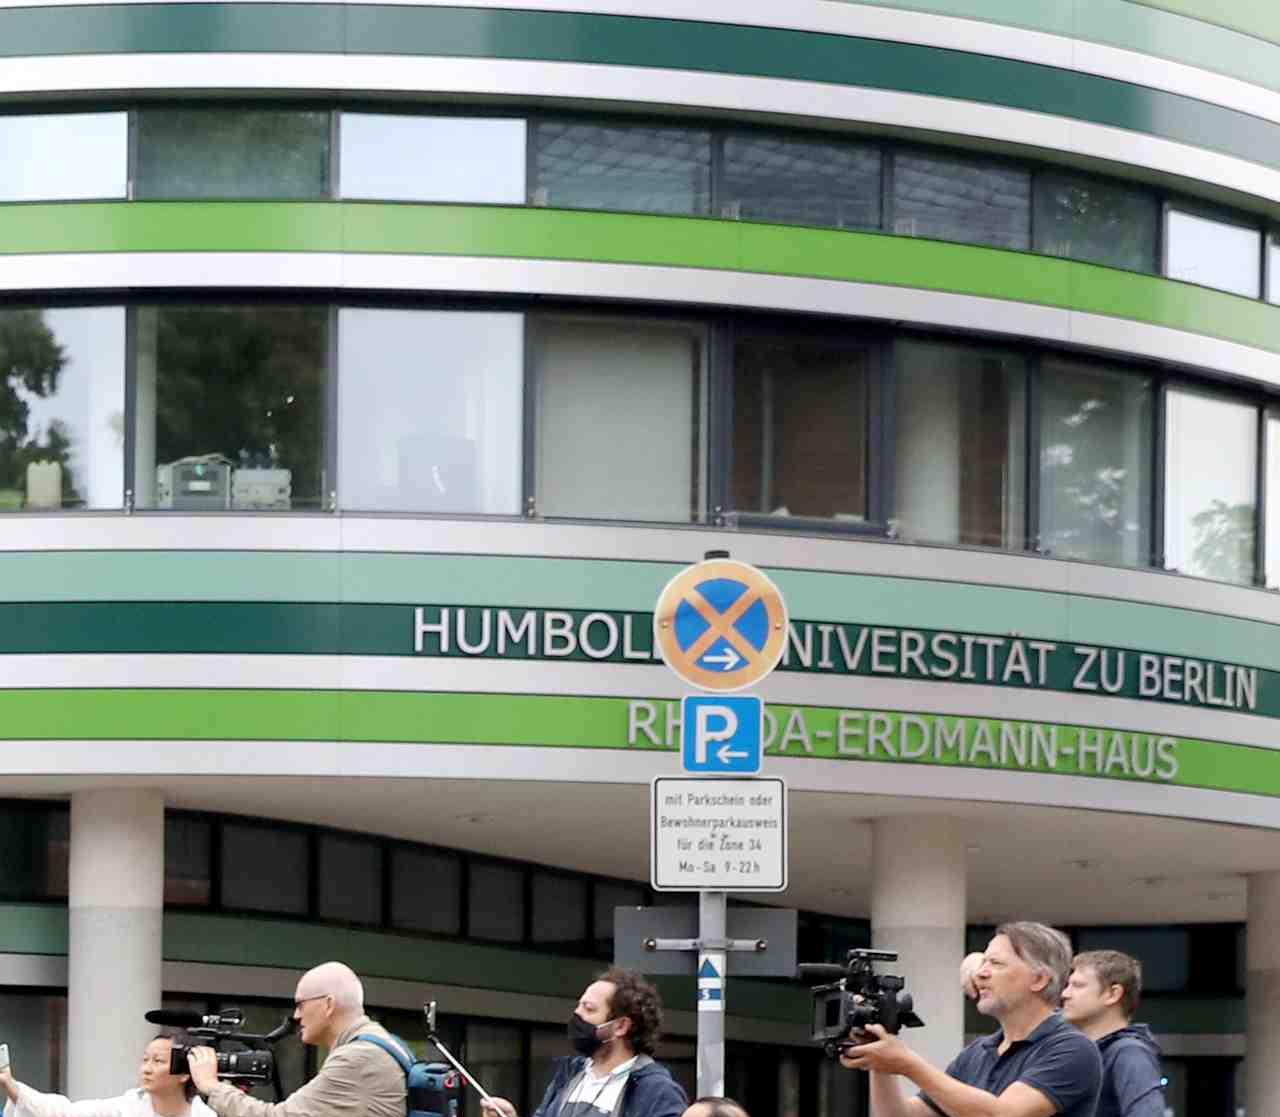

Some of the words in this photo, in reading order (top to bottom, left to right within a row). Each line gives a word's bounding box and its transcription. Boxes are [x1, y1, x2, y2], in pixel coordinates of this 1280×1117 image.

[1073, 646, 1126, 693] ZU
[1140, 653, 1258, 710] BERLIN
[627, 700, 1180, 780] RHDA-ERDMANN-HAUS
[695, 705, 738, 763] P
[665, 794, 682, 806] mit
[687, 794, 745, 806] Parkschein
[749, 794, 773, 806] oder
[660, 816, 778, 830] Bewohnerparkausweis
[677, 839, 692, 850] für
[697, 839, 714, 850] die
[720, 838, 744, 851] Zone
